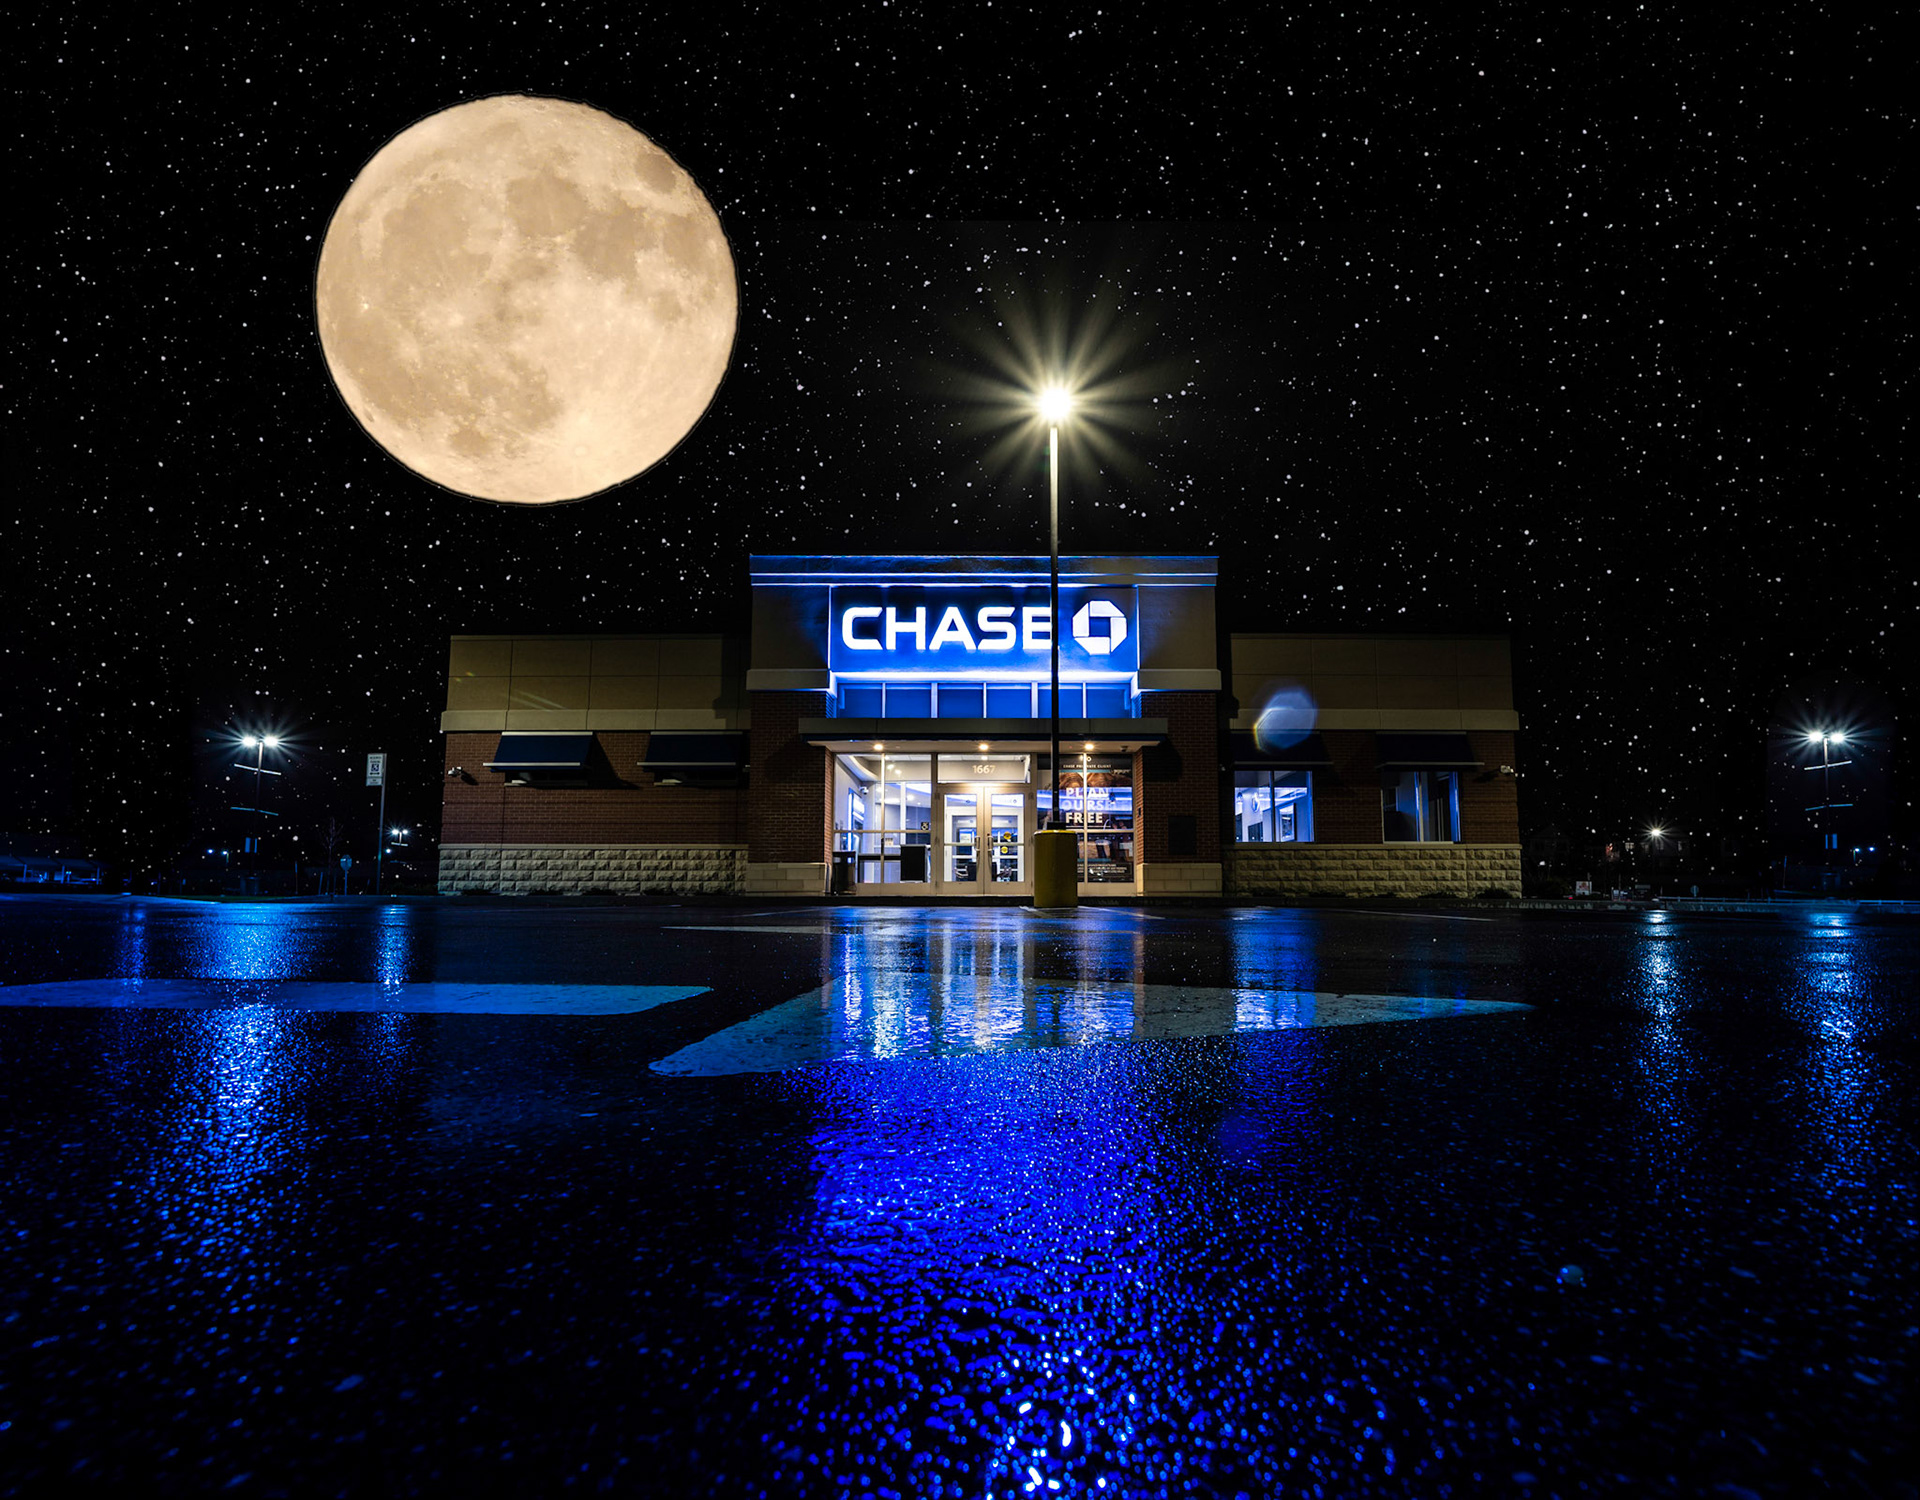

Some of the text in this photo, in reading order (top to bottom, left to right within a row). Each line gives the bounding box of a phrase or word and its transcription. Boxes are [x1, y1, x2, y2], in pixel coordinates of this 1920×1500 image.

[841, 606, 1052, 650] CHASE
[972, 765, 996, 774] 1667
[1066, 787, 1109, 798] PLAN
[1066, 812, 1103, 824] FREE
